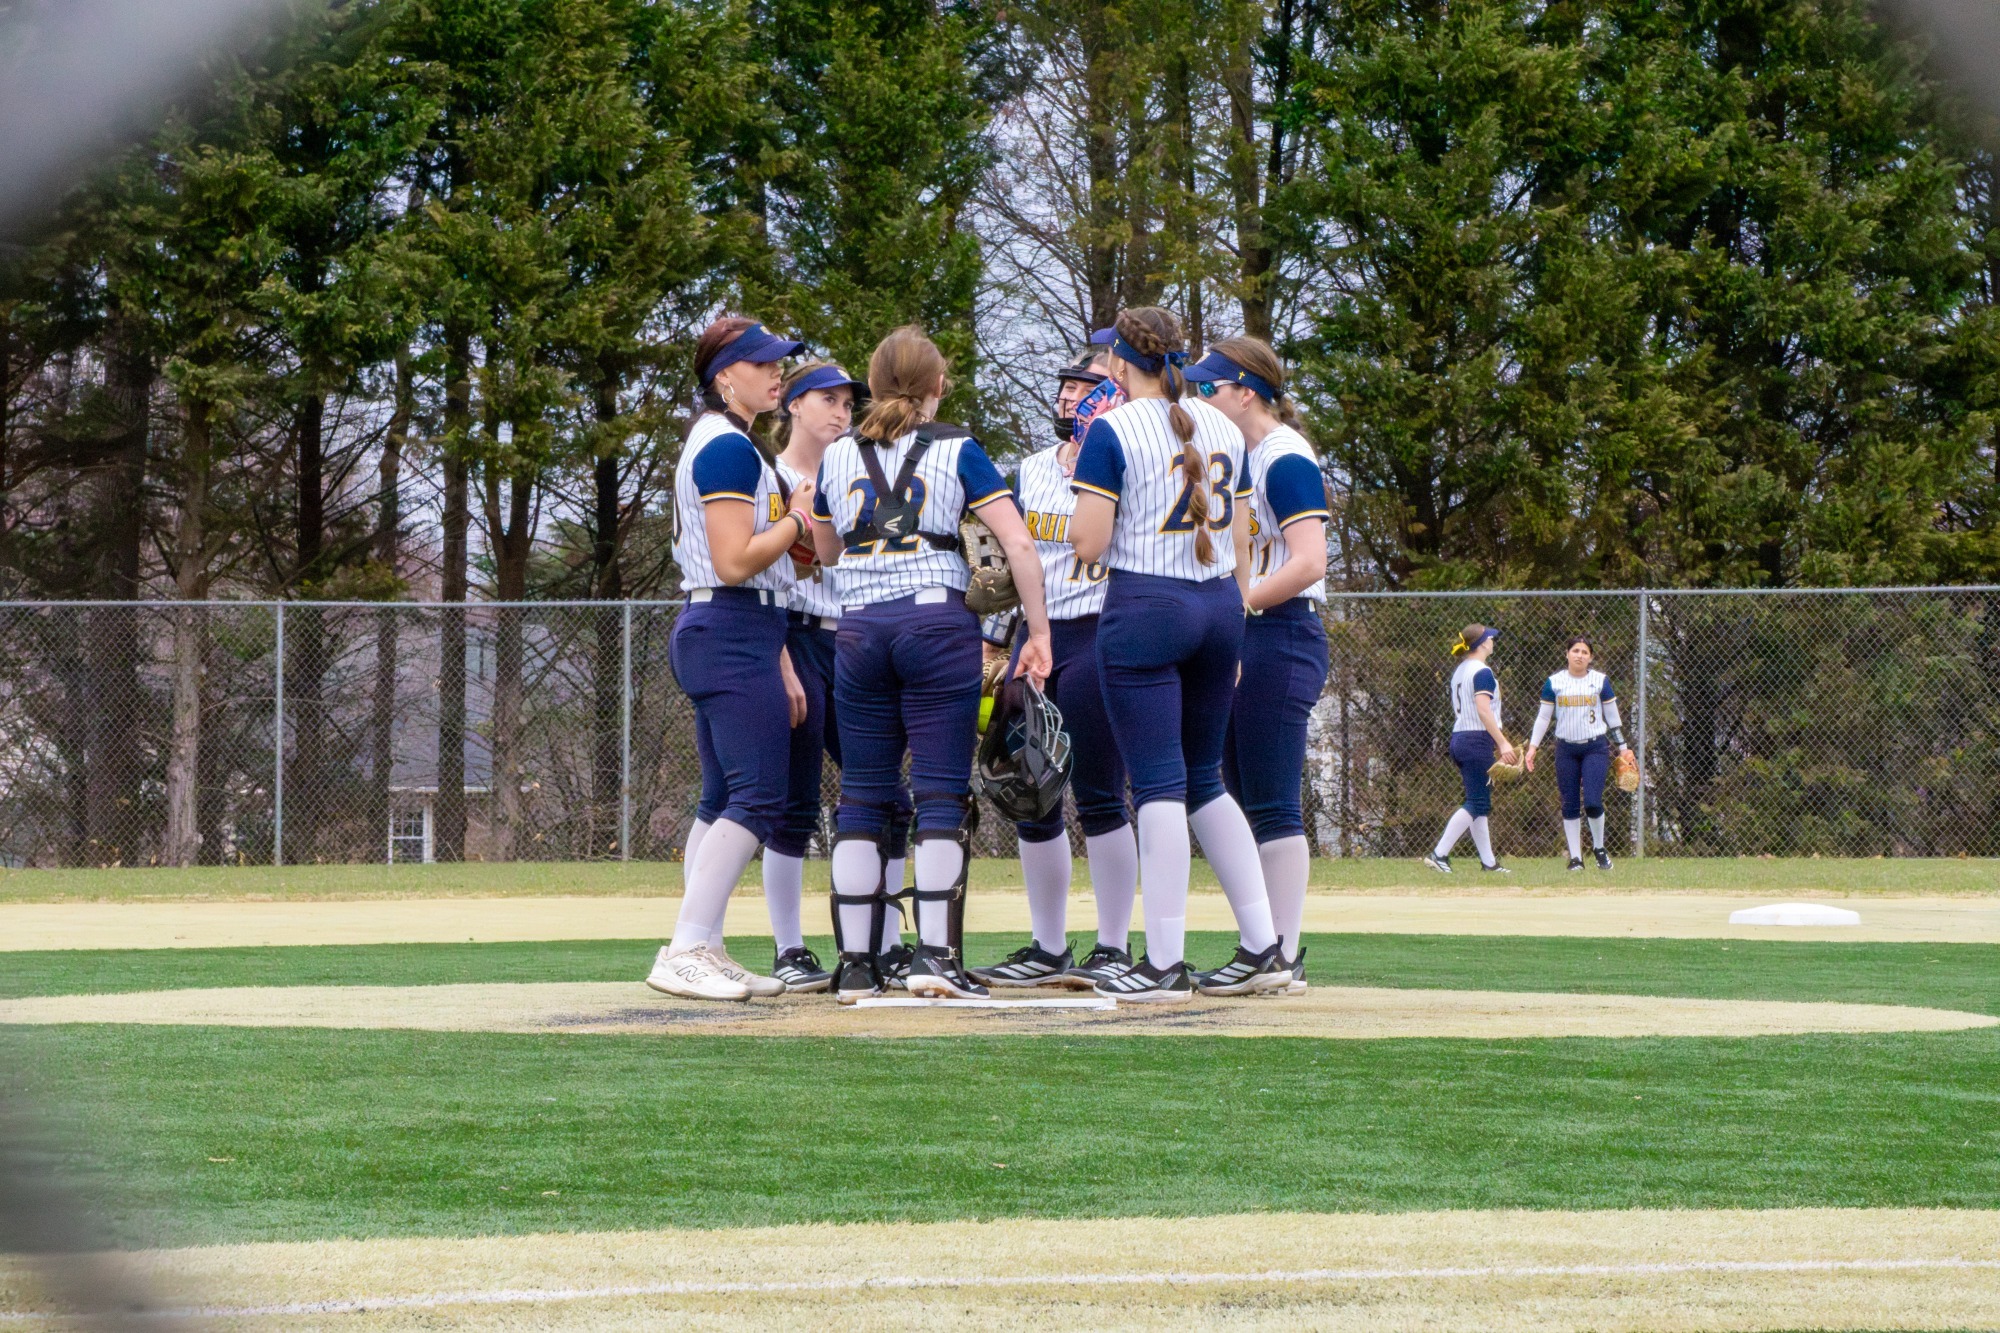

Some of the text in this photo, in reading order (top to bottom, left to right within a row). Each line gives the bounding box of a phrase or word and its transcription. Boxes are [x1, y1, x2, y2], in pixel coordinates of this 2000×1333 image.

[1158, 452, 1233, 534] 23
[845, 473, 928, 557] 22
[1024, 510, 1073, 543] RUI
[1066, 553, 1109, 583] 16
[1589, 709, 1596, 724] 3
